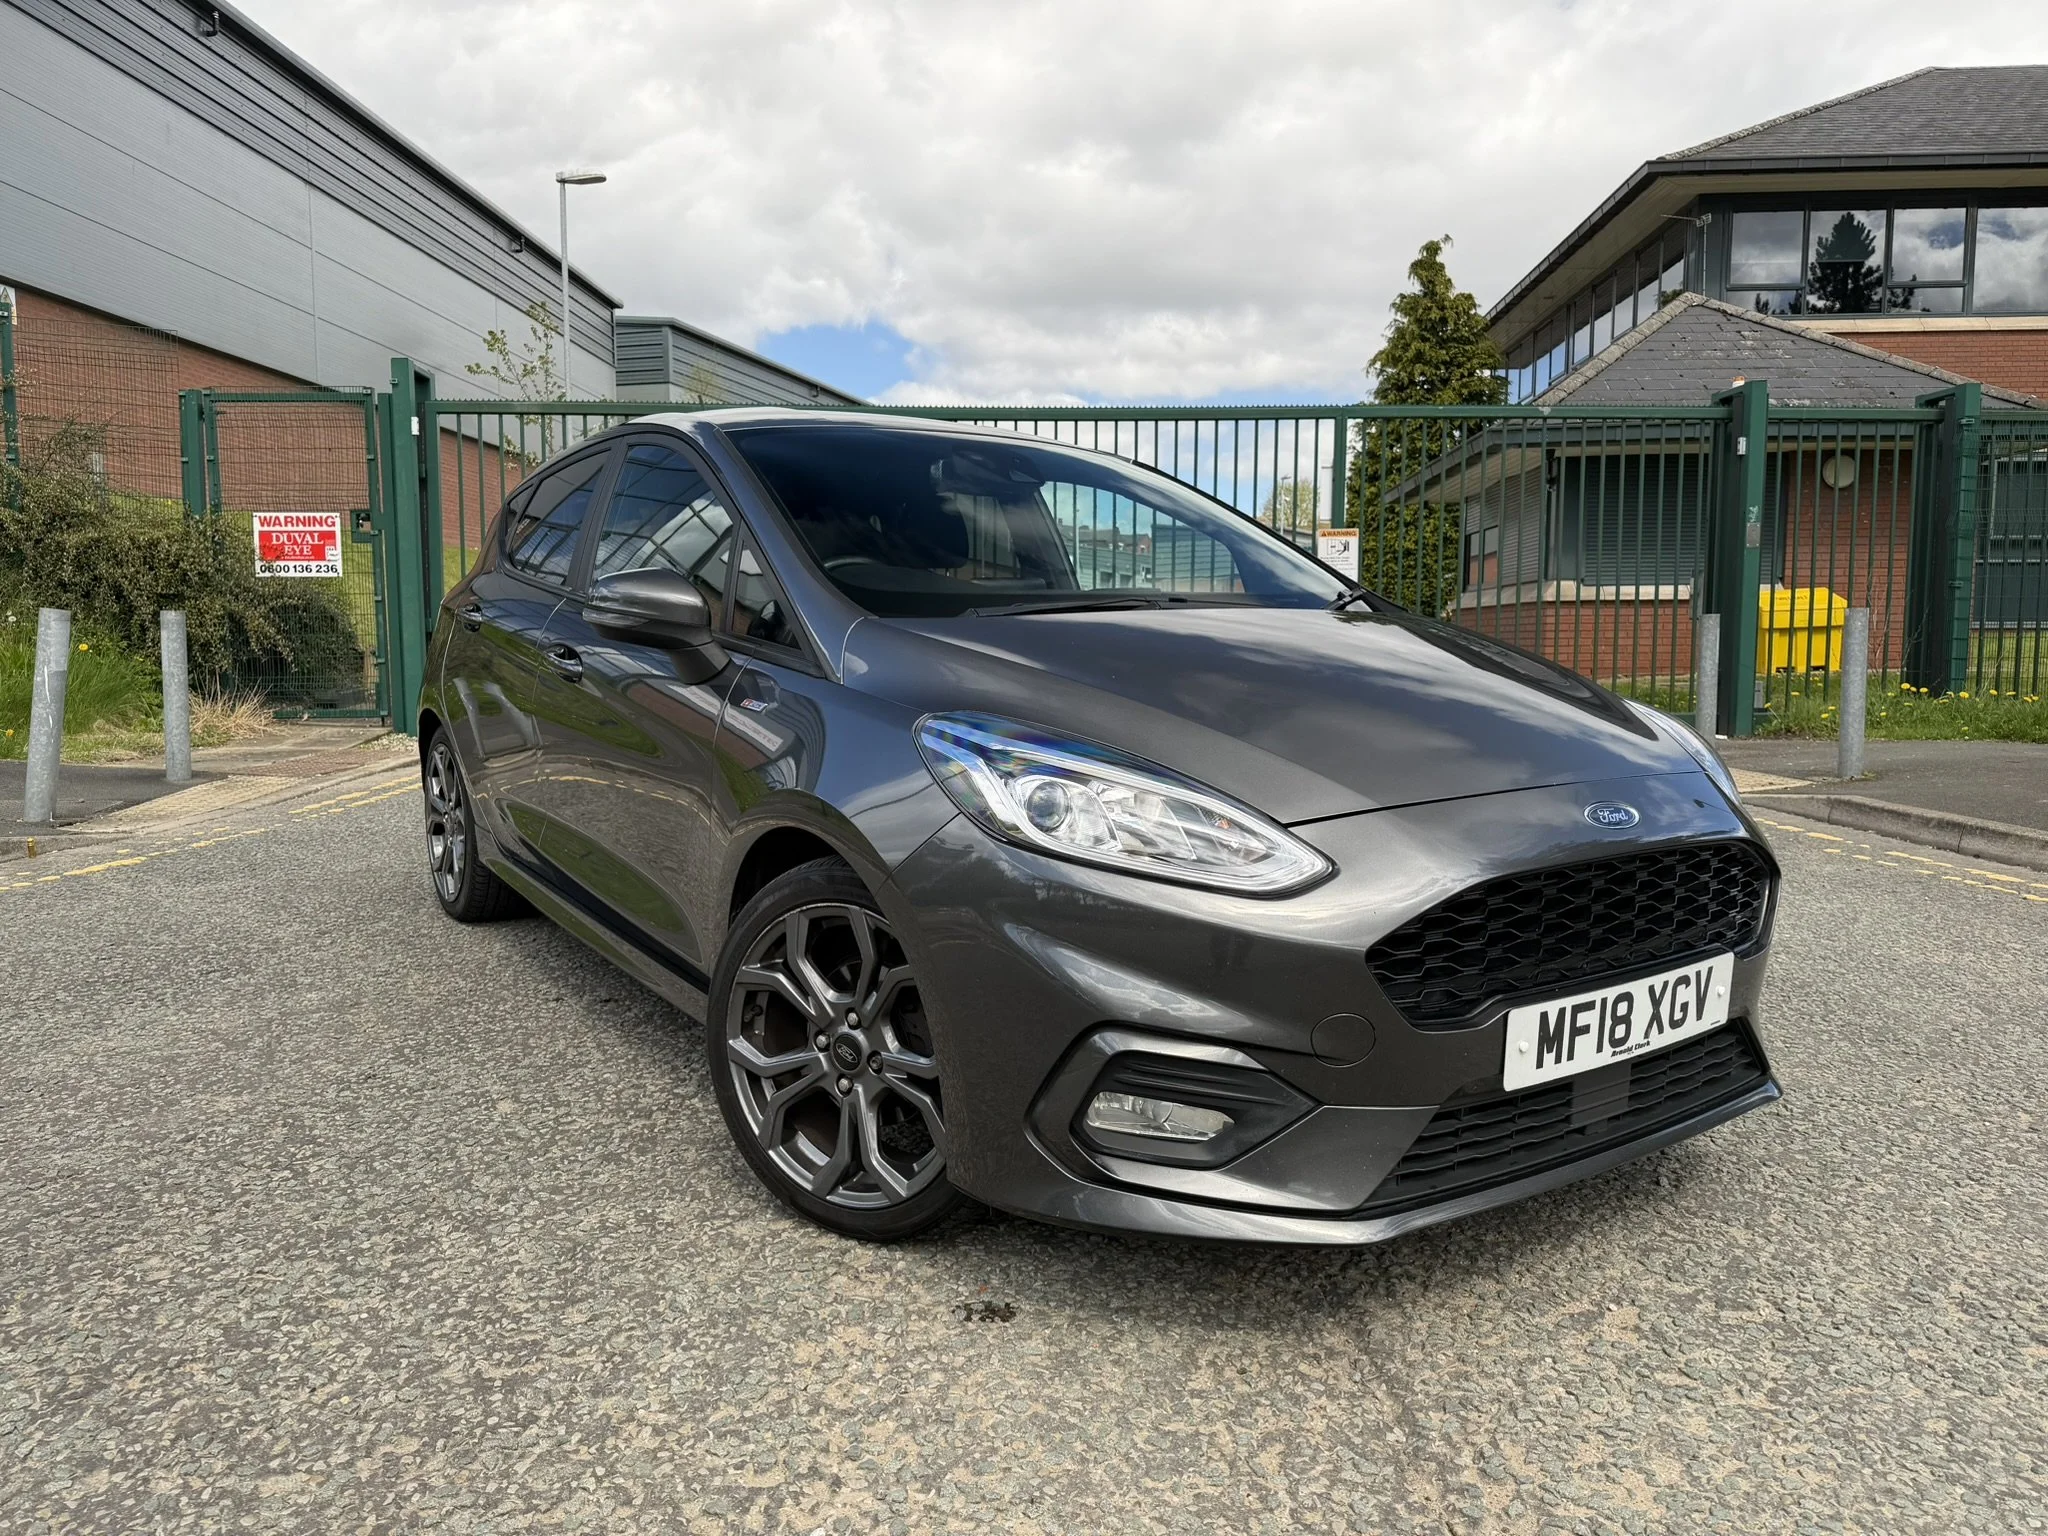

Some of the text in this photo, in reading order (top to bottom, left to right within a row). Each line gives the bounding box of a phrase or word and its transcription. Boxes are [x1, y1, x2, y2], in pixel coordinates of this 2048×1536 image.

[258, 515, 336, 528] WARNING
[271, 532, 324, 545] DUVAL
[284, 545, 312, 556] EYE
[293, 564, 313, 574] 136
[315, 564, 338, 574] 236
[1597, 808, 1628, 822] Ford
[1536, 966, 1713, 1069] MF18 XGV
